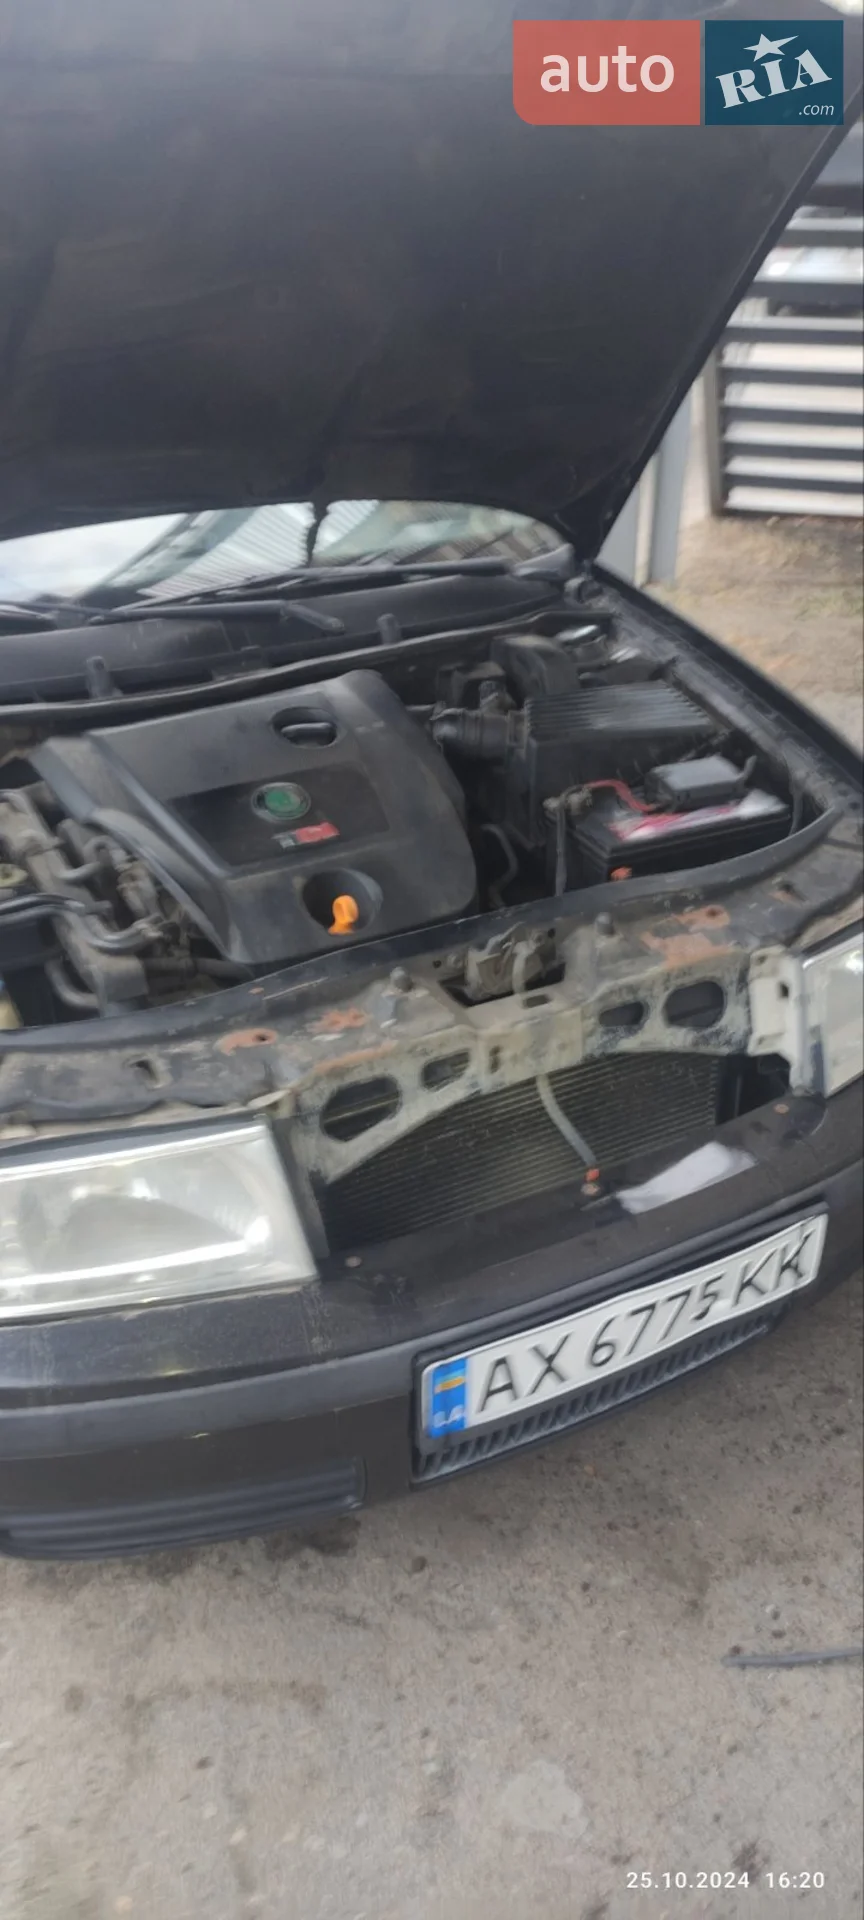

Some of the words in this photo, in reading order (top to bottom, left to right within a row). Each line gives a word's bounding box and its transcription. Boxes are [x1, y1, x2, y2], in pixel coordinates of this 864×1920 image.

[475, 1331, 572, 1413] AX
[586, 1272, 725, 1368] 6775
[732, 1231, 813, 1306] KK
